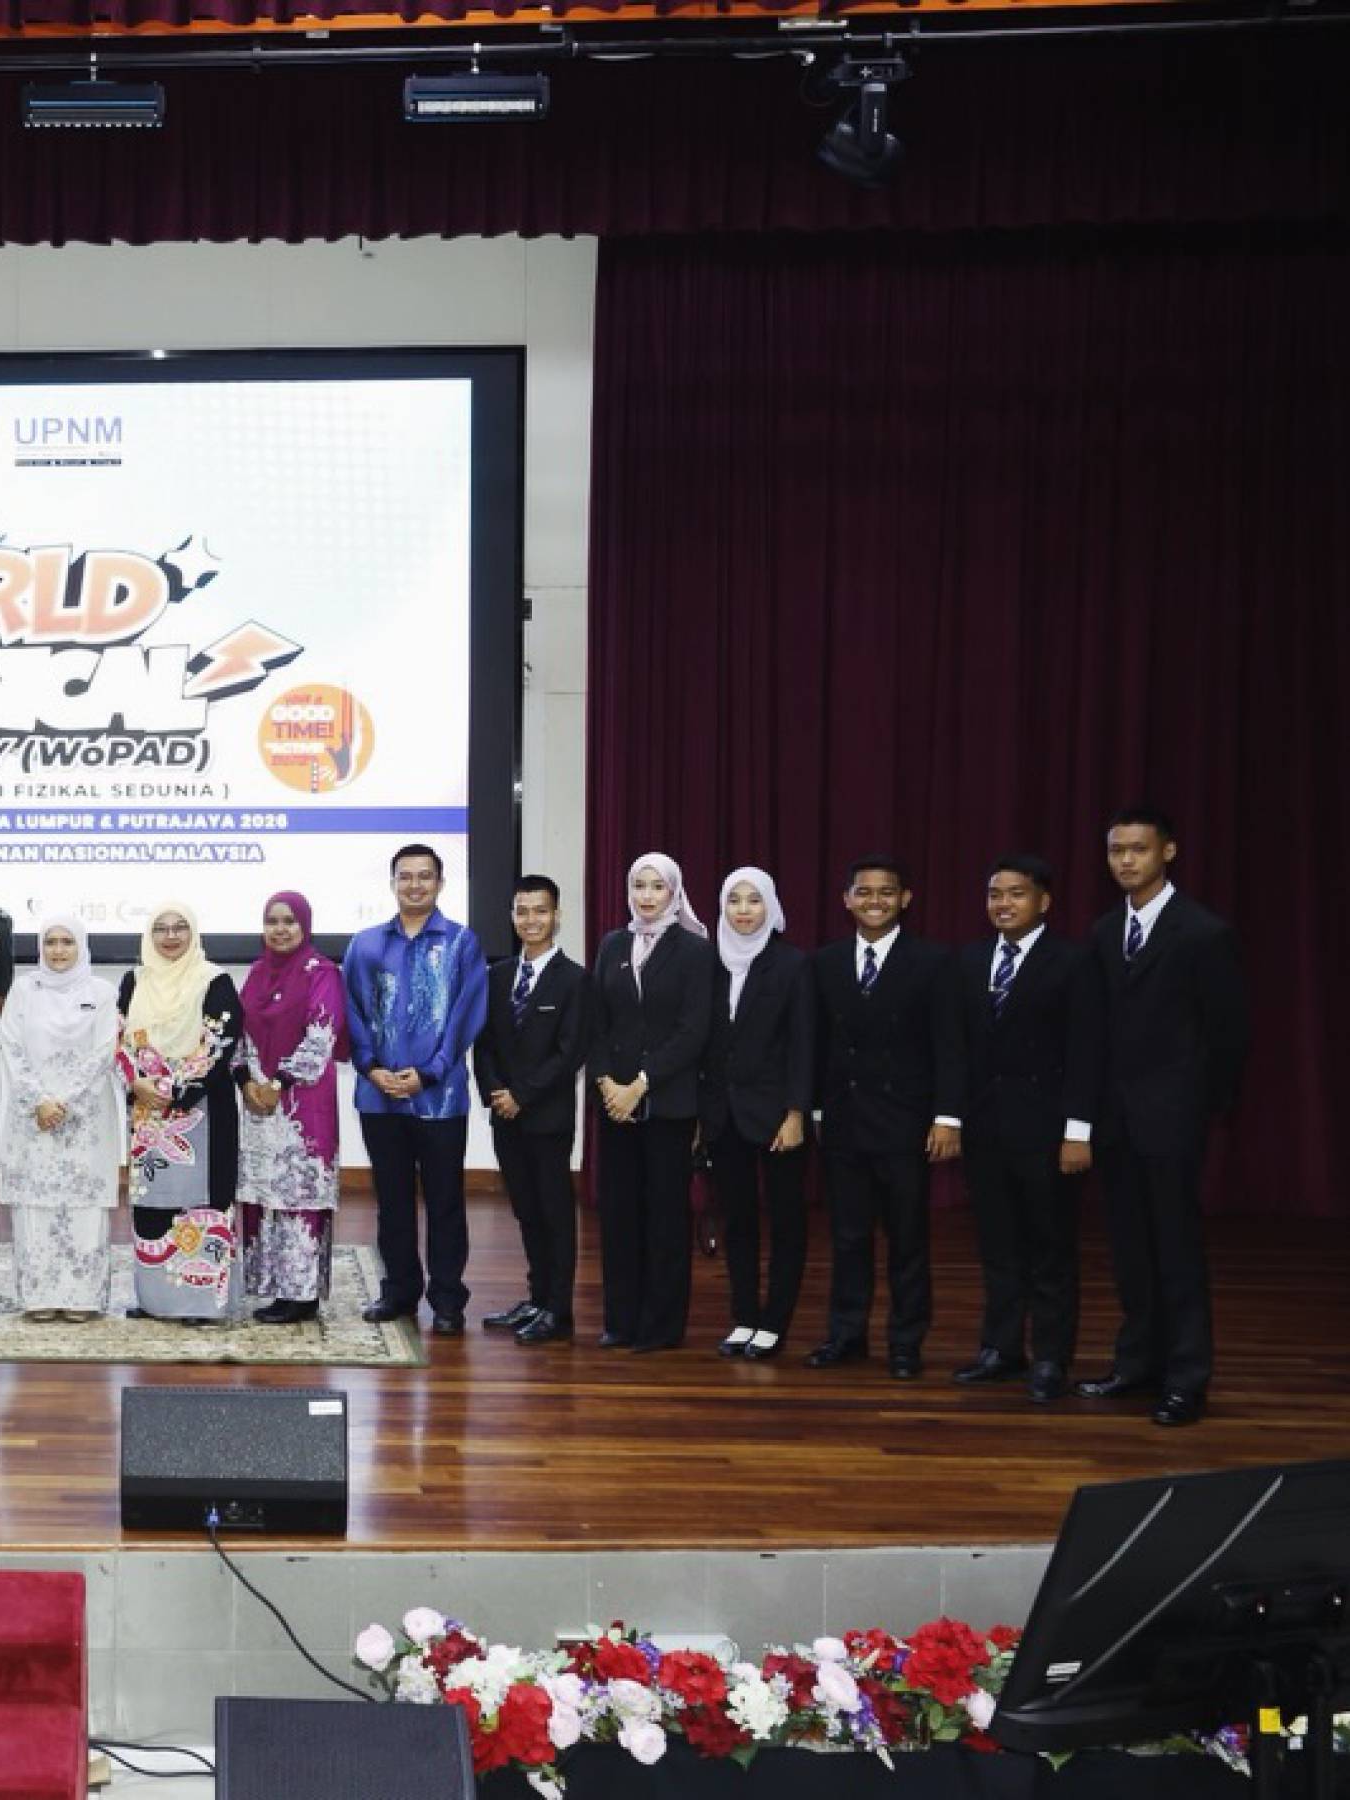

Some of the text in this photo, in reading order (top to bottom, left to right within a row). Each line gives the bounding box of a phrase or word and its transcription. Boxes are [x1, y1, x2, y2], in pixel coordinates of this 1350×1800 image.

[14, 417, 122, 445] UPNM
[272, 720, 335, 739] TIME!
[21, 739, 211, 773] (WoPAD)
[13, 783, 101, 798] FIZIKAL
[110, 783, 214, 798] SEDUNIA
[16, 814, 95, 829] LUMPUR
[100, 814, 113, 829] &
[118, 813, 236, 829] PUTRAJAYA
[44, 843, 151, 862] NASIONAL
[153, 843, 265, 862] MALAYSIA
